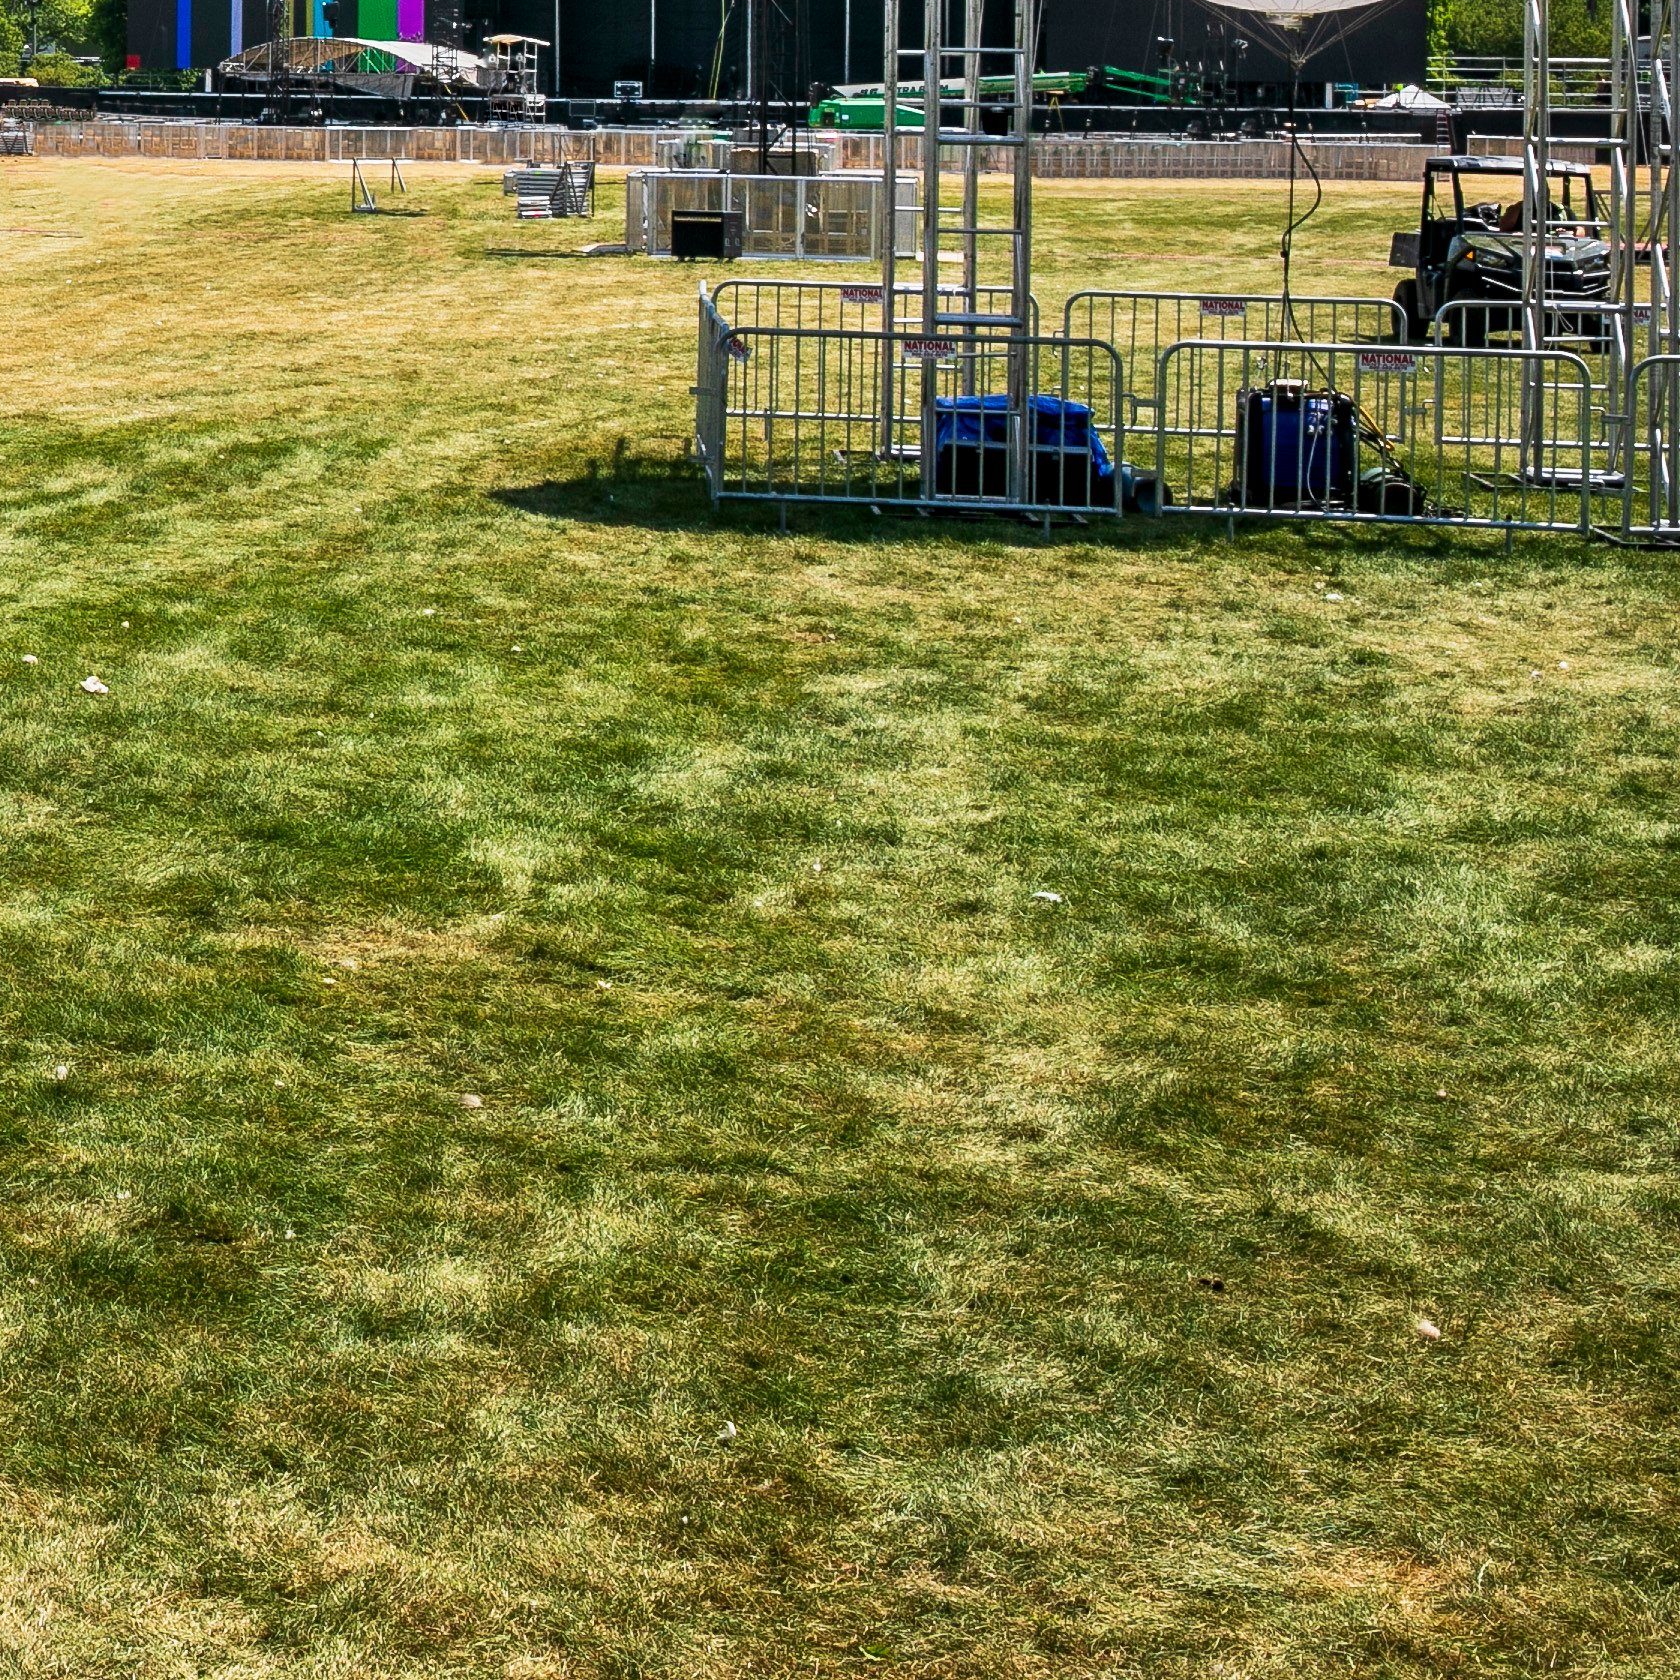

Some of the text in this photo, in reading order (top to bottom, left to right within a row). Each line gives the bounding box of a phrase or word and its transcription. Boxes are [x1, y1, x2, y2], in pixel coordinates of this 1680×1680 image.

[843, 288, 883, 298] NATIONAL
[1202, 301, 1245, 310] NATIONAL
[904, 340, 955, 351] NATIONAL
[1361, 353, 1415, 364] NATIONAL
